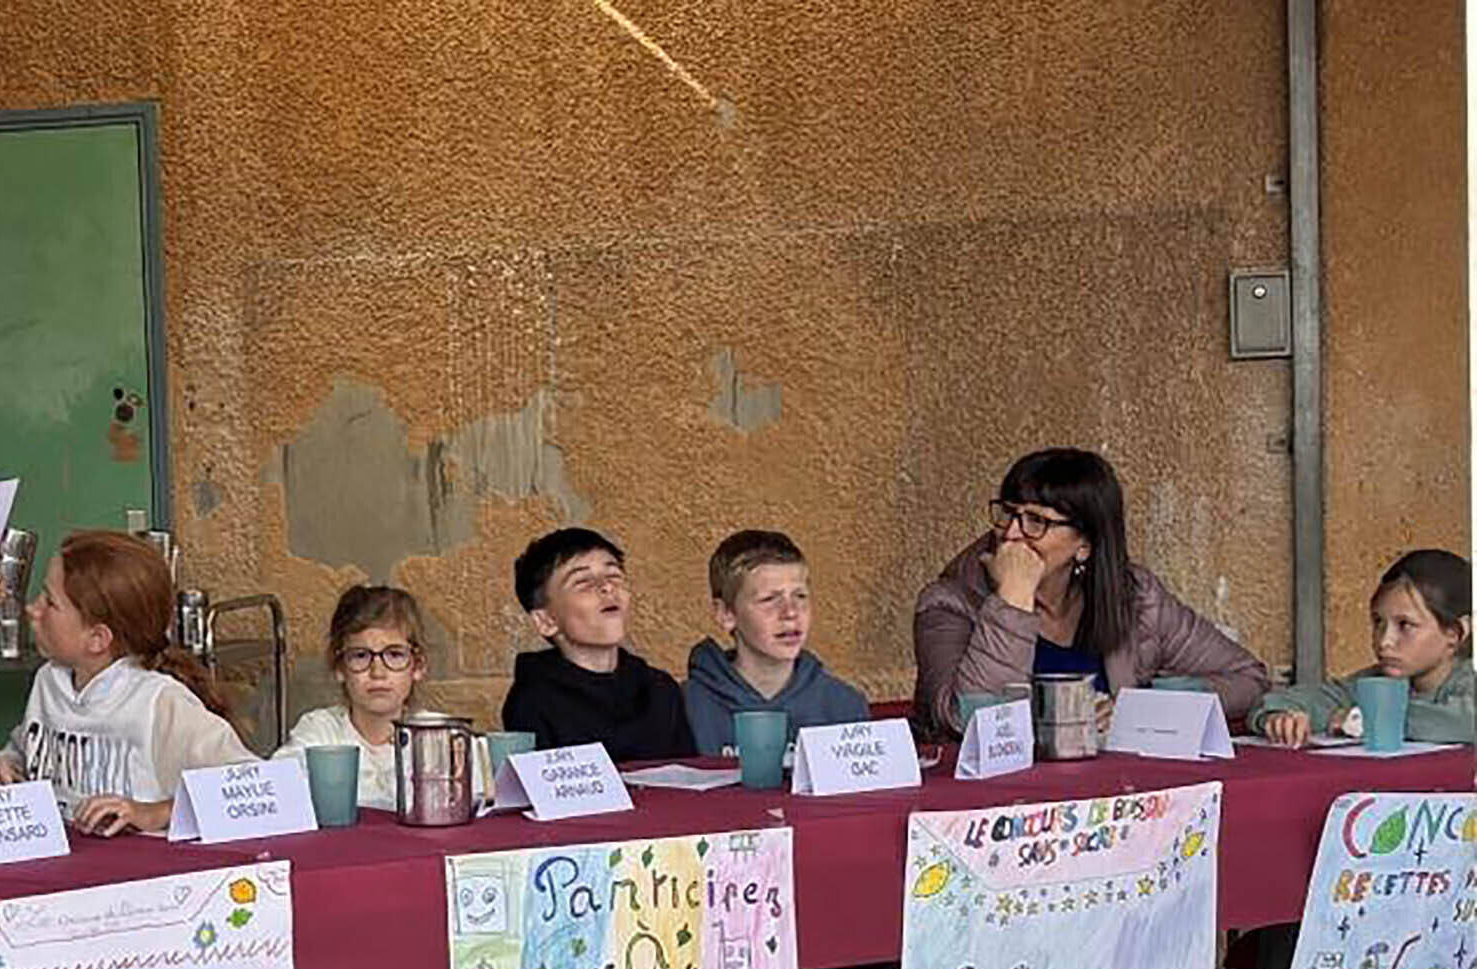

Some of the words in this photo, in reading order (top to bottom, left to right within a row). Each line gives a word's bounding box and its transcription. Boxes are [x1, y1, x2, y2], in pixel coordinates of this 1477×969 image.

[963, 818, 990, 849] LE
[1018, 838, 1059, 867] SANS
[1333, 868, 1453, 904] RECETTES
